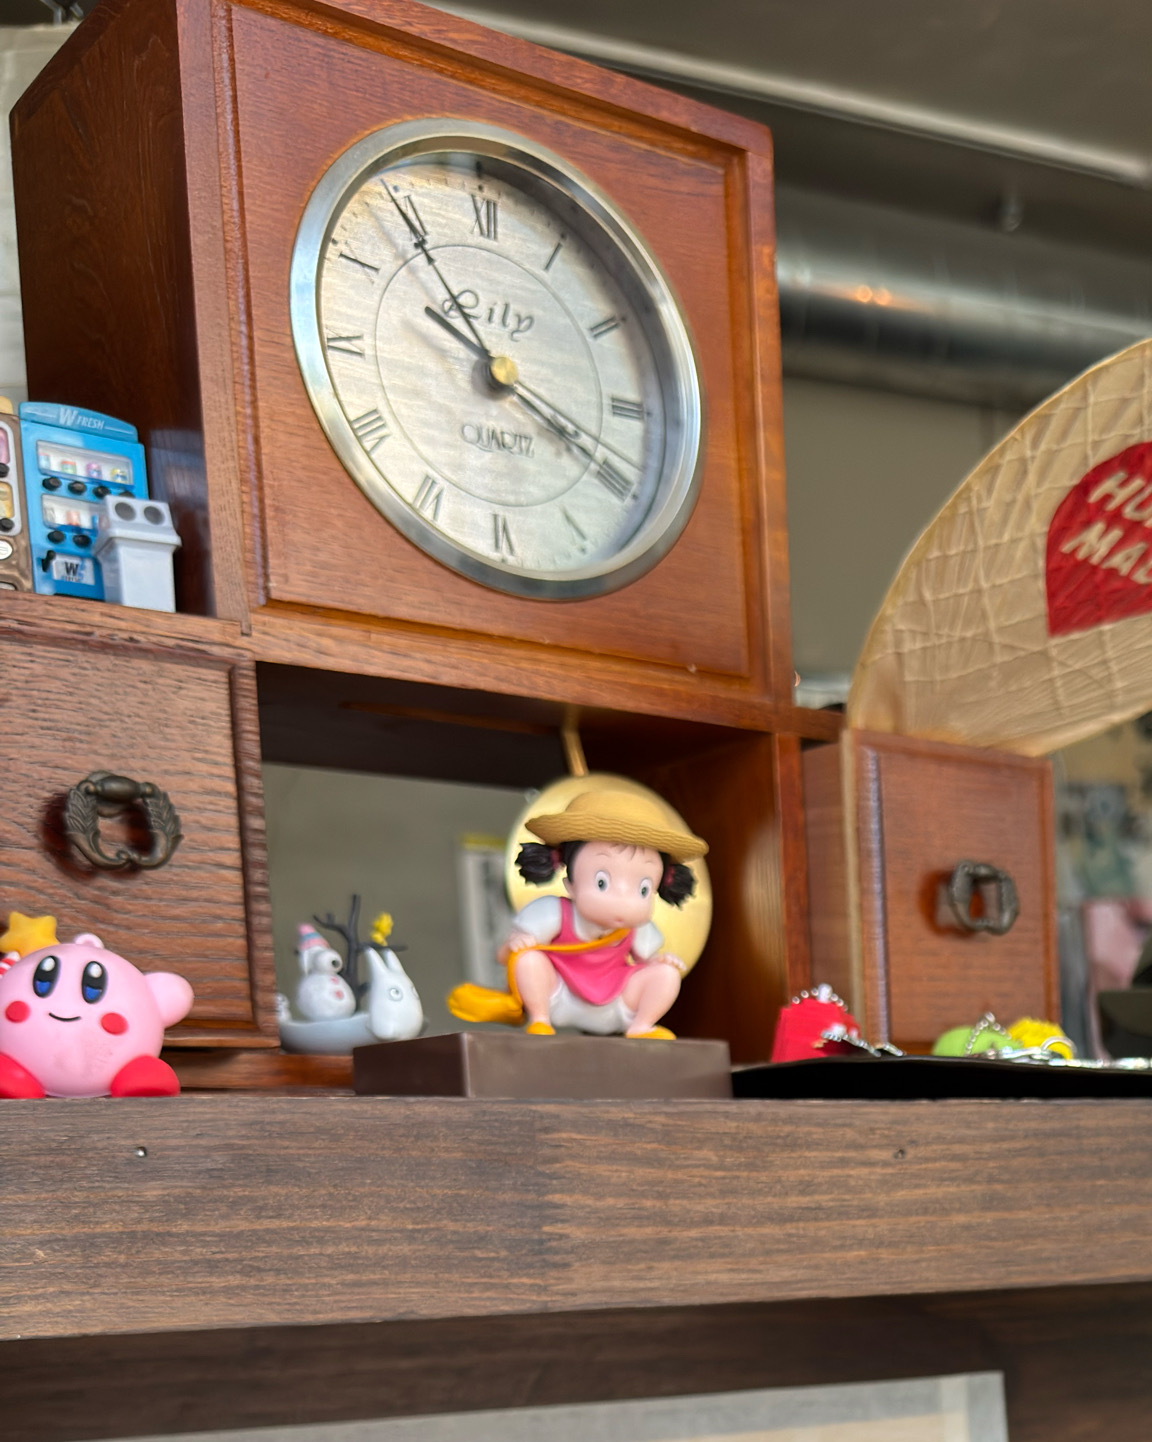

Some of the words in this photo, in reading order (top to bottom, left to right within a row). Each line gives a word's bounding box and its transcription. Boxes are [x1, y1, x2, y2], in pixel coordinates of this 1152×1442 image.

[470, 193, 499, 241] XII
[442, 289, 535, 343] Lily
[589, 316, 621, 339] II
[327, 334, 366, 358] IX
[58, 407, 79, 428] W
[77, 415, 105, 431] FRESH
[610, 395, 644, 420] III
[351, 407, 391, 456] VIII
[462, 423, 535, 458] QUARTZ
[415, 474, 445, 522] VII
[493, 513, 516, 558] VI
